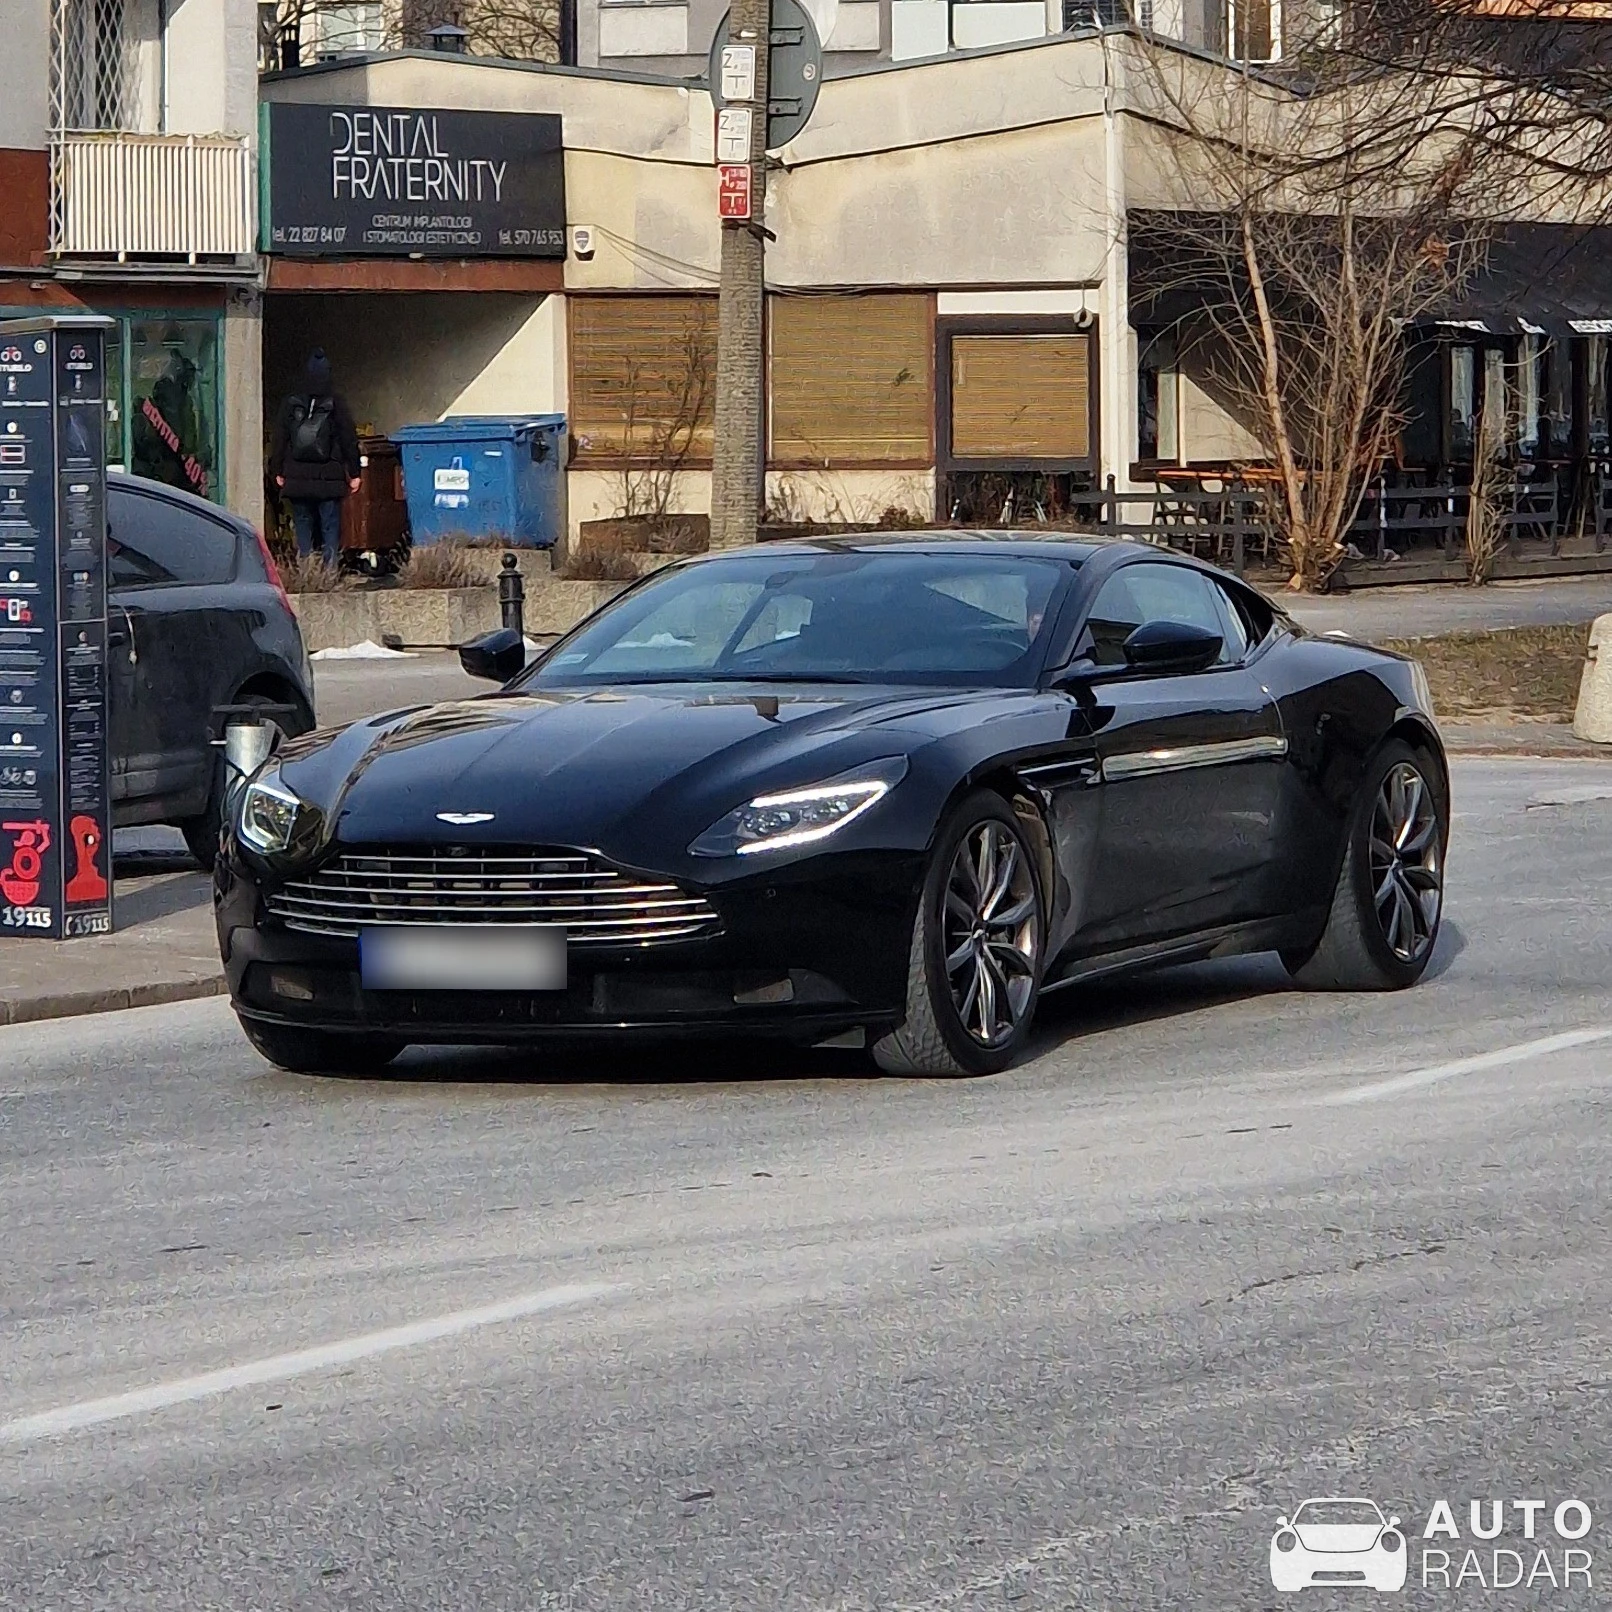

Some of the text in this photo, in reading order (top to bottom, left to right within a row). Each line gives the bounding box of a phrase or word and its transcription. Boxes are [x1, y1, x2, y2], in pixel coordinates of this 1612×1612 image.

[330, 112, 449, 157] DENTAL
[333, 156, 507, 202] FRATERNITY
[288, 227, 301, 243] 22
[321, 227, 333, 243] 84
[2, 906, 52, 928] 19115
[74, 912, 110, 935] 19115
